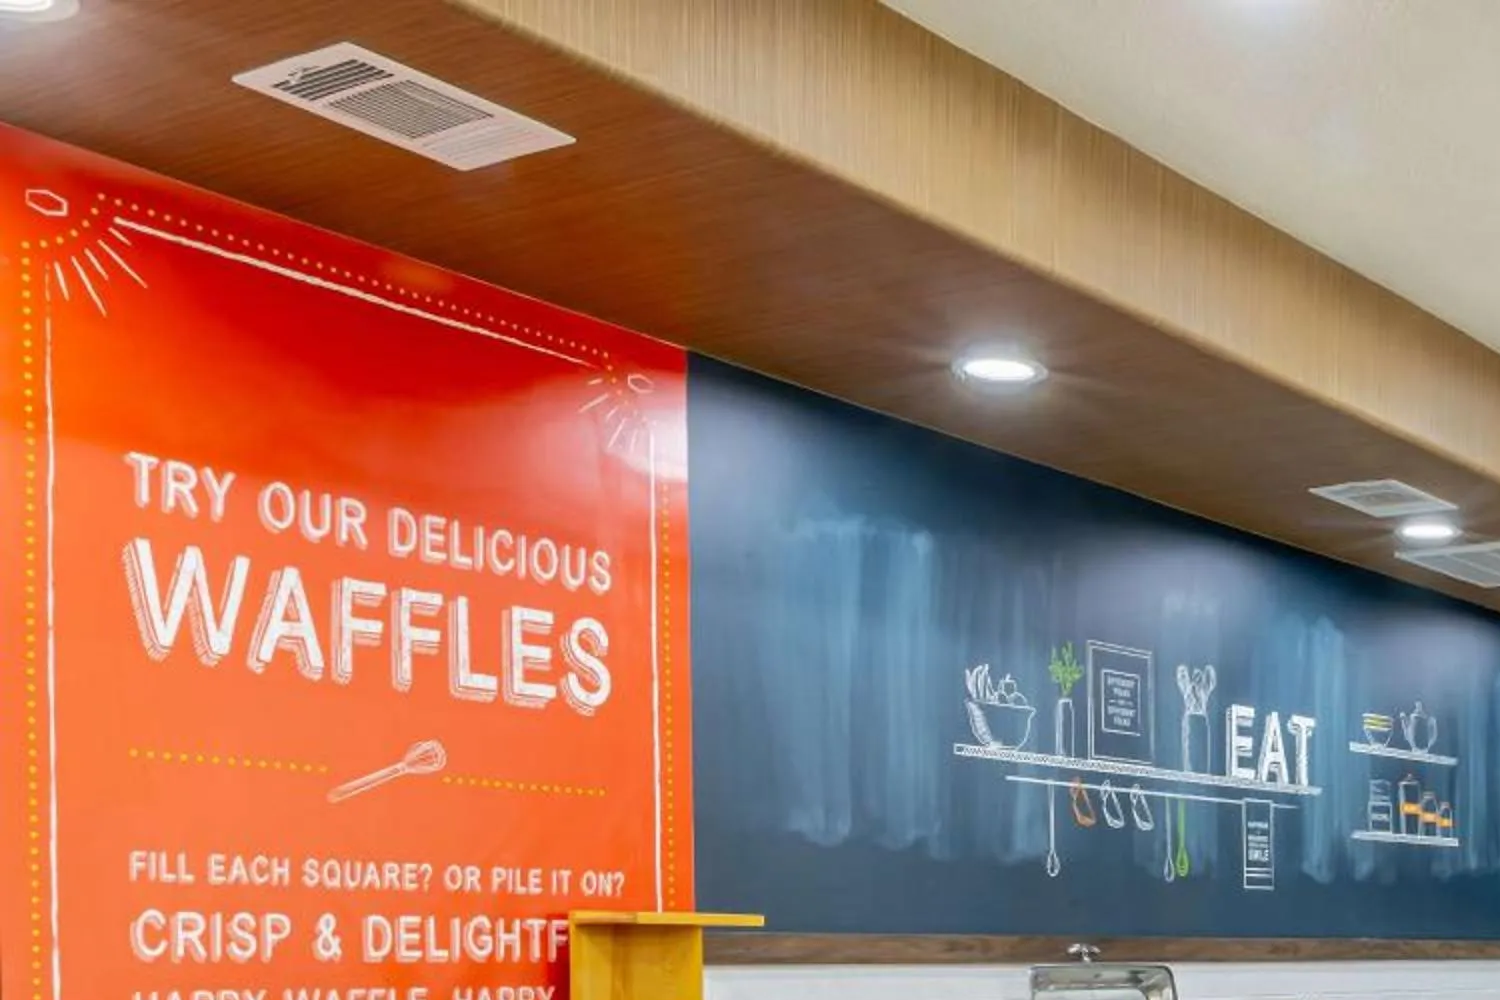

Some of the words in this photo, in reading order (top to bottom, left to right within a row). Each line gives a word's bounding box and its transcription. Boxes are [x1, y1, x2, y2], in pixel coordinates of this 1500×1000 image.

[124, 451, 236, 522] TRY
[258, 481, 368, 550] OUR
[388, 507, 611, 595] DELICIOUS
[122, 537, 611, 717] WAFFLES
[1226, 704, 1316, 787] EAT
[129, 850, 195, 884] FILL
[207, 853, 290, 886] EACH
[303, 858, 433, 891] SQUARE?
[444, 864, 481, 892] OR
[491, 866, 543, 895] PILE
[552, 869, 572, 895] IT
[580, 870, 625, 897] ON?
[130, 909, 291, 963] CRISP
[312, 913, 342, 961] &
